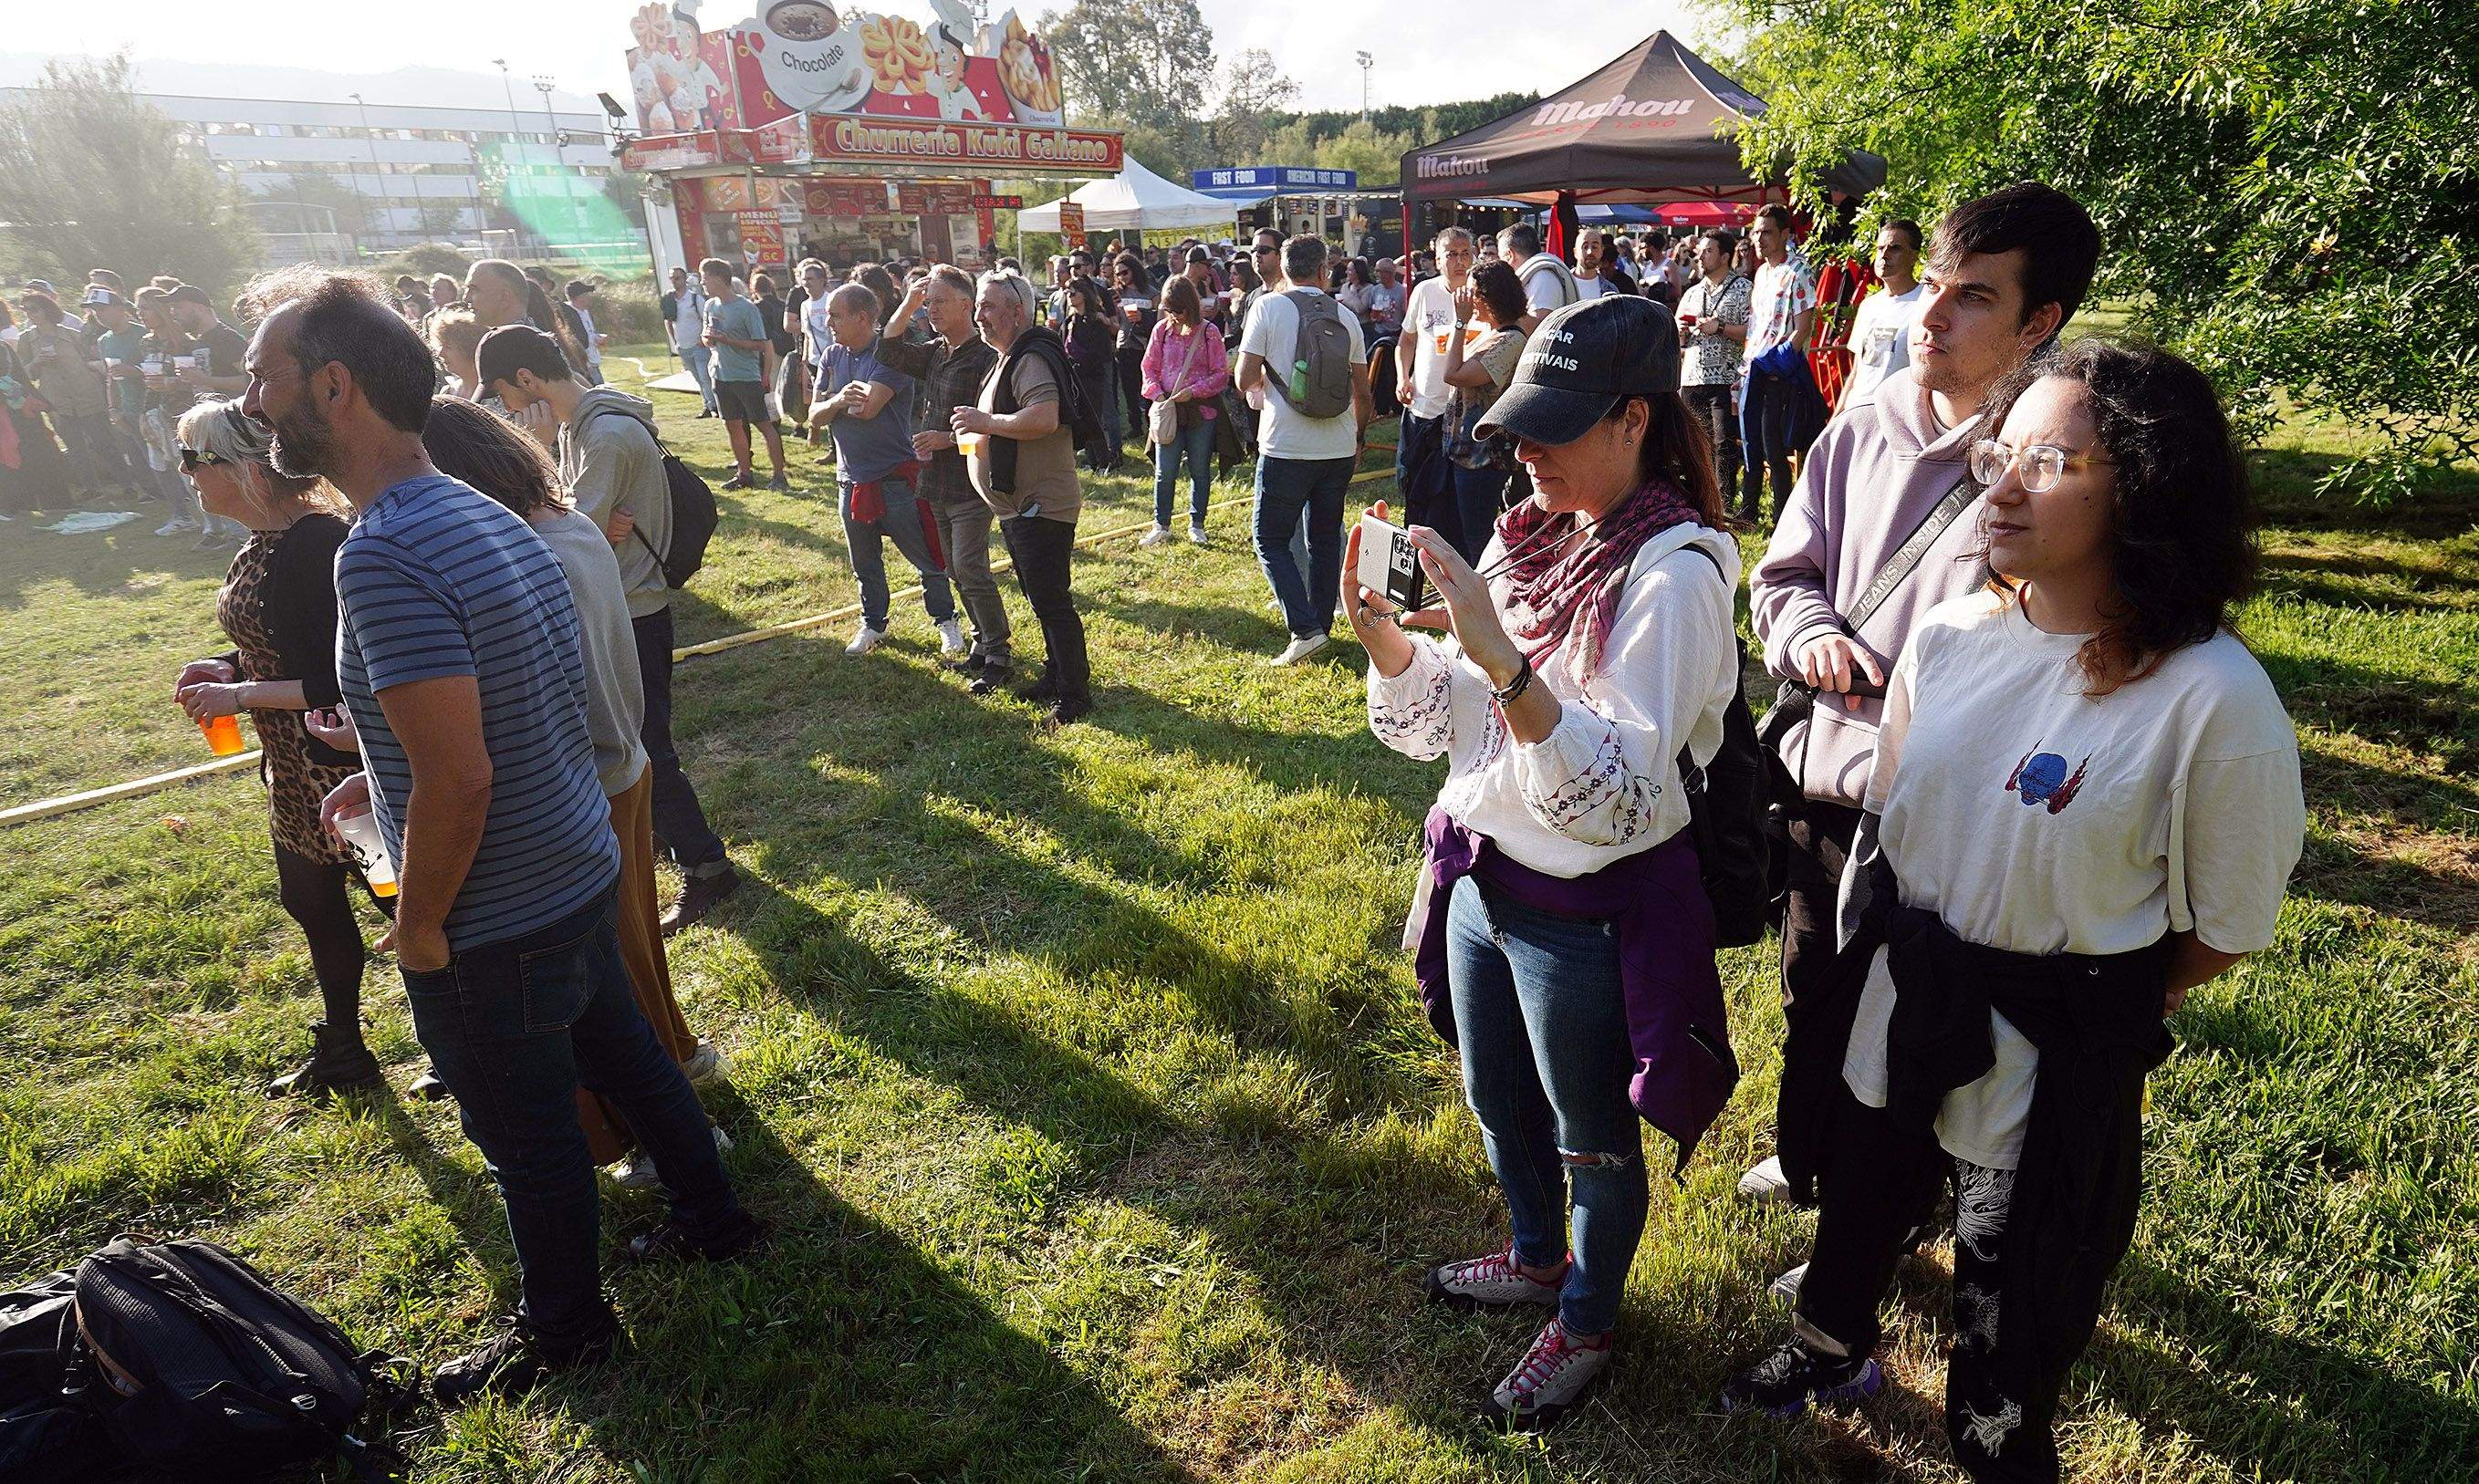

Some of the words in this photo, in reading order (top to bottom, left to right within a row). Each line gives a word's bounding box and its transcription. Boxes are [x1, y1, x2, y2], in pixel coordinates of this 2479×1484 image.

[781, 44, 844, 72] Chocolate
[1530, 94, 1695, 126] Mahou
[1614, 117, 1677, 131] 1890
[835, 119, 961, 157] Churrería
[965, 126, 1022, 159] Kuki
[1026, 130, 1109, 162] Galiano
[1212, 171, 1232, 185] FAST
[1234, 170, 1256, 184] FOOD
[1416, 155, 1490, 179] Mahou
[1859, 564, 1901, 616] JEANS
[1901, 504, 1952, 563] INSIDE
